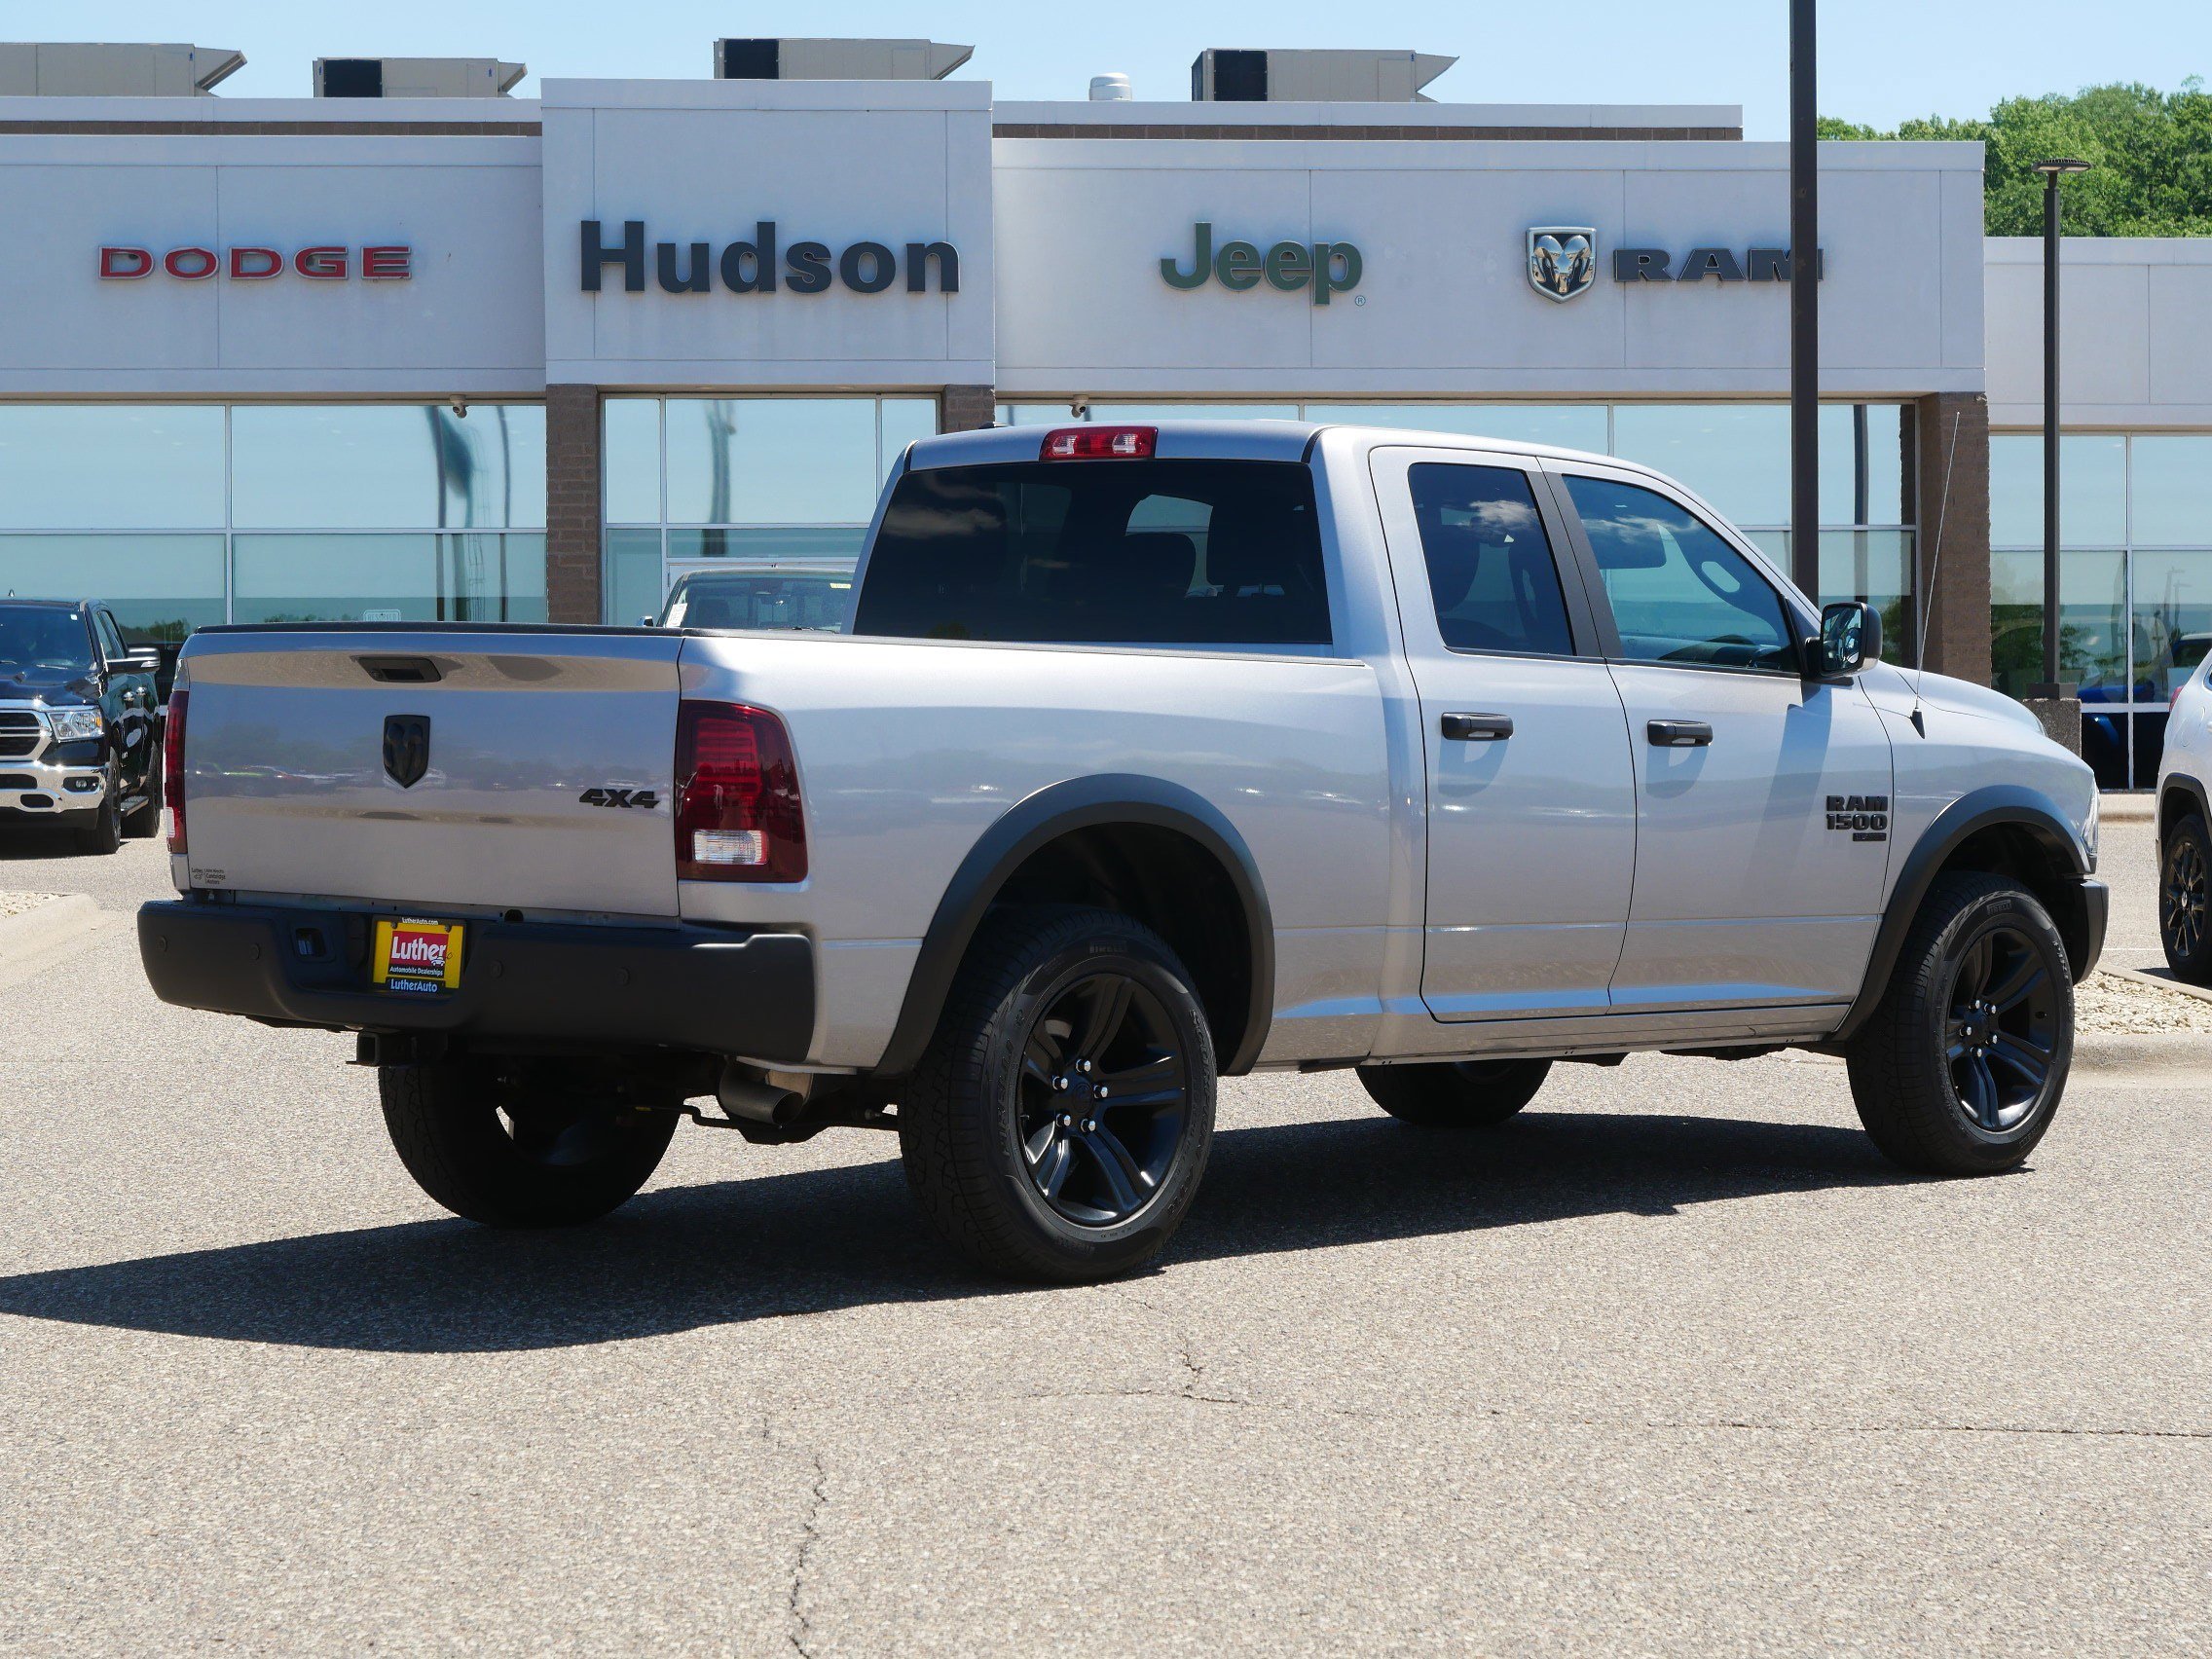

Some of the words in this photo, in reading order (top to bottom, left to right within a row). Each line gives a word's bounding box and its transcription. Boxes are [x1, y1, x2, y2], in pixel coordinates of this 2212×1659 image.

[98, 245, 412, 280] DODGE
[581, 220, 960, 295] Hudson
[1161, 221, 1363, 306] Jeep
[1613, 248, 1825, 282] RAM
[579, 788, 660, 809] 4X4
[1825, 795, 1889, 812] RAM
[1825, 814, 1889, 830] 1500
[401, 917, 439, 926] LutherAuto.com
[390, 936, 447, 961] Luther
[389, 966, 417, 975] Automobile
[417, 968, 443, 977] Dealerships
[389, 977, 438, 993] LutherAuto
